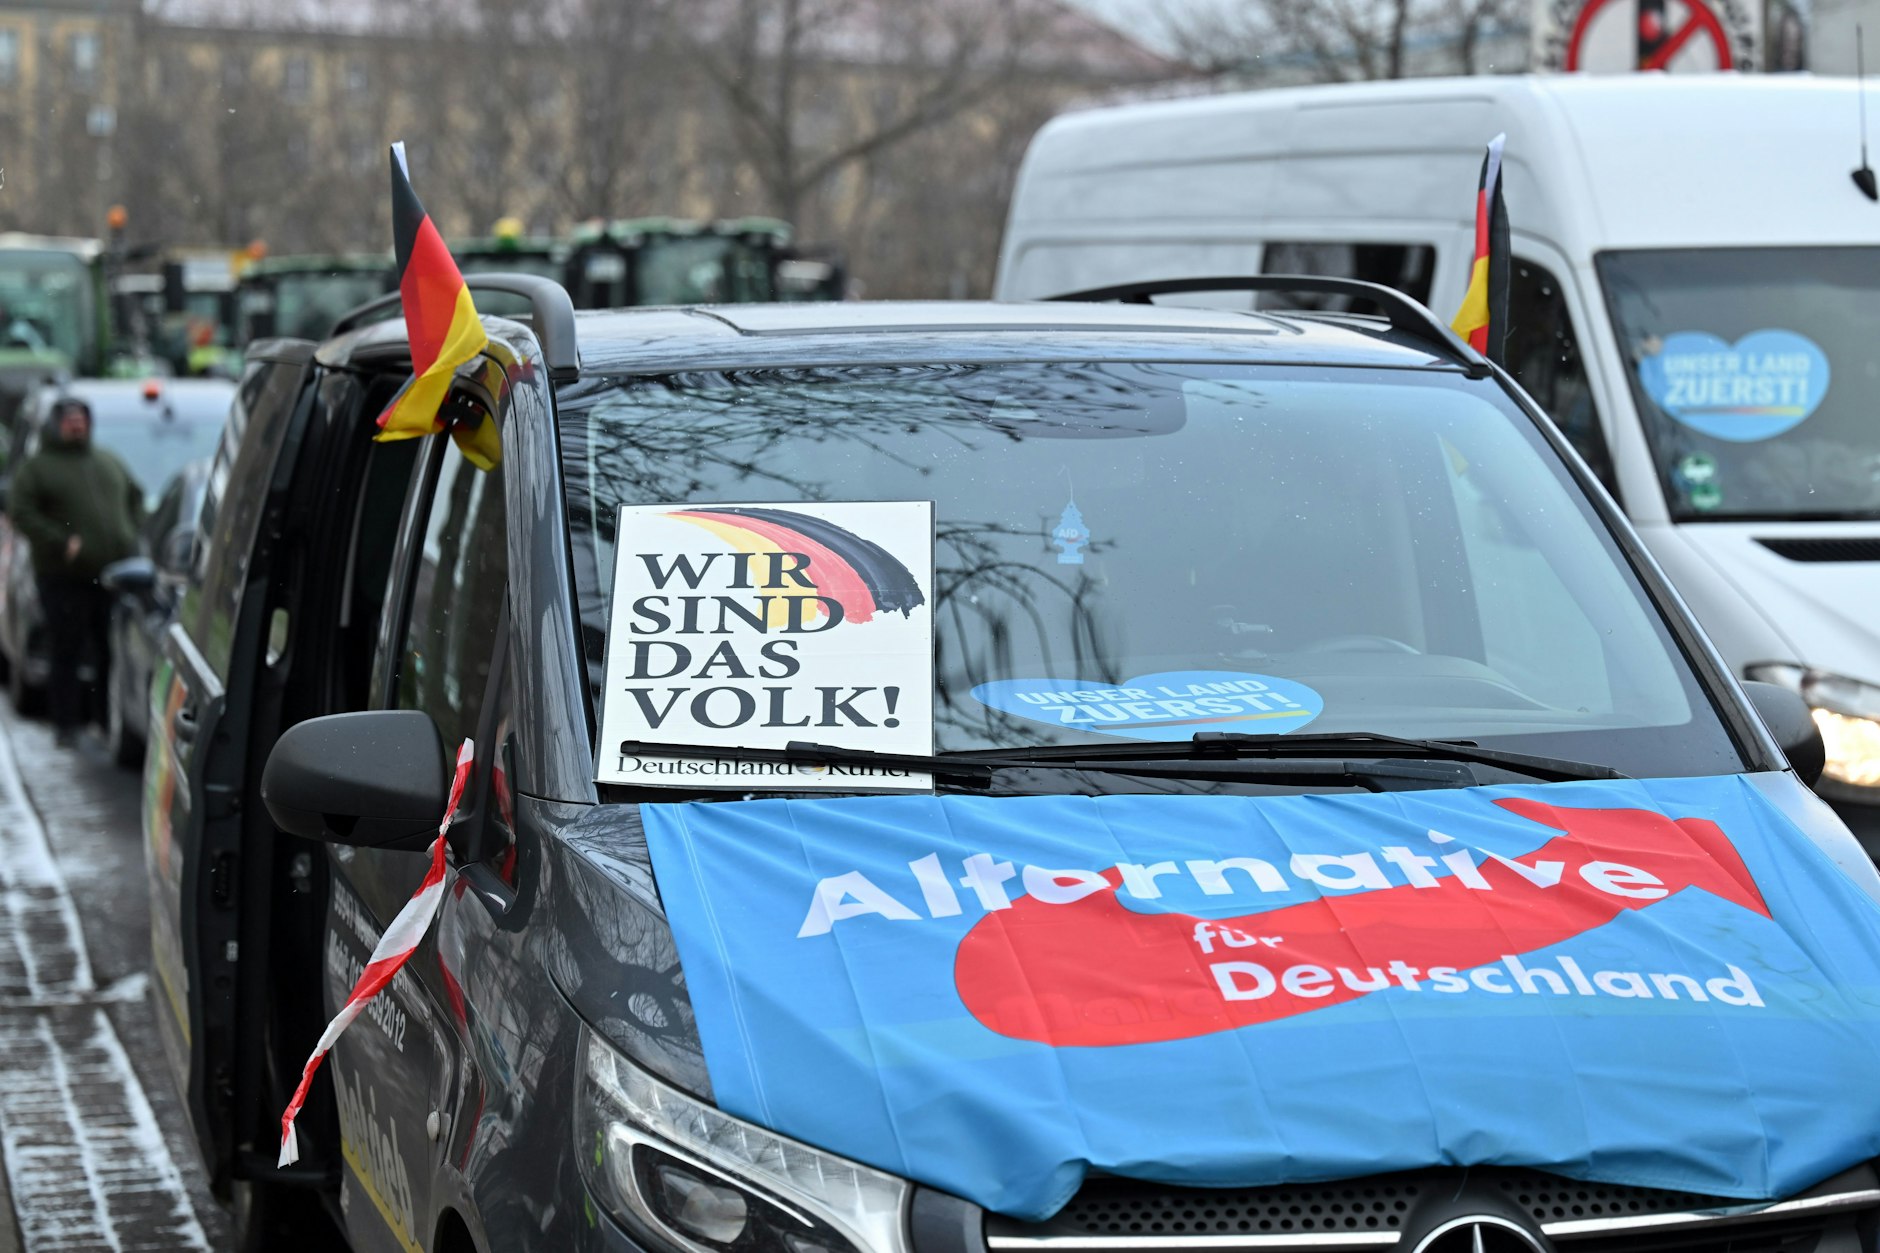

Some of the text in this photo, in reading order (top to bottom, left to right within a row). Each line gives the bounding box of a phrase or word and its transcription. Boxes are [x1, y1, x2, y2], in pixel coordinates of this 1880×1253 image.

[1663, 352, 1811, 374] UNSER LAND
[1663, 376, 1808, 406] ZUERST!
[636, 552, 819, 590] WIR
[629, 595, 845, 635] SIND
[625, 639, 801, 680] DAS
[624, 685, 901, 730] VOLK!
[1014, 680, 1270, 706] UNSER LAND
[1048, 691, 1303, 724] ZUERST!
[617, 756, 794, 776] Deutschland
[1193, 920, 1284, 954] für
[1208, 955, 1766, 1008] Deutschland
